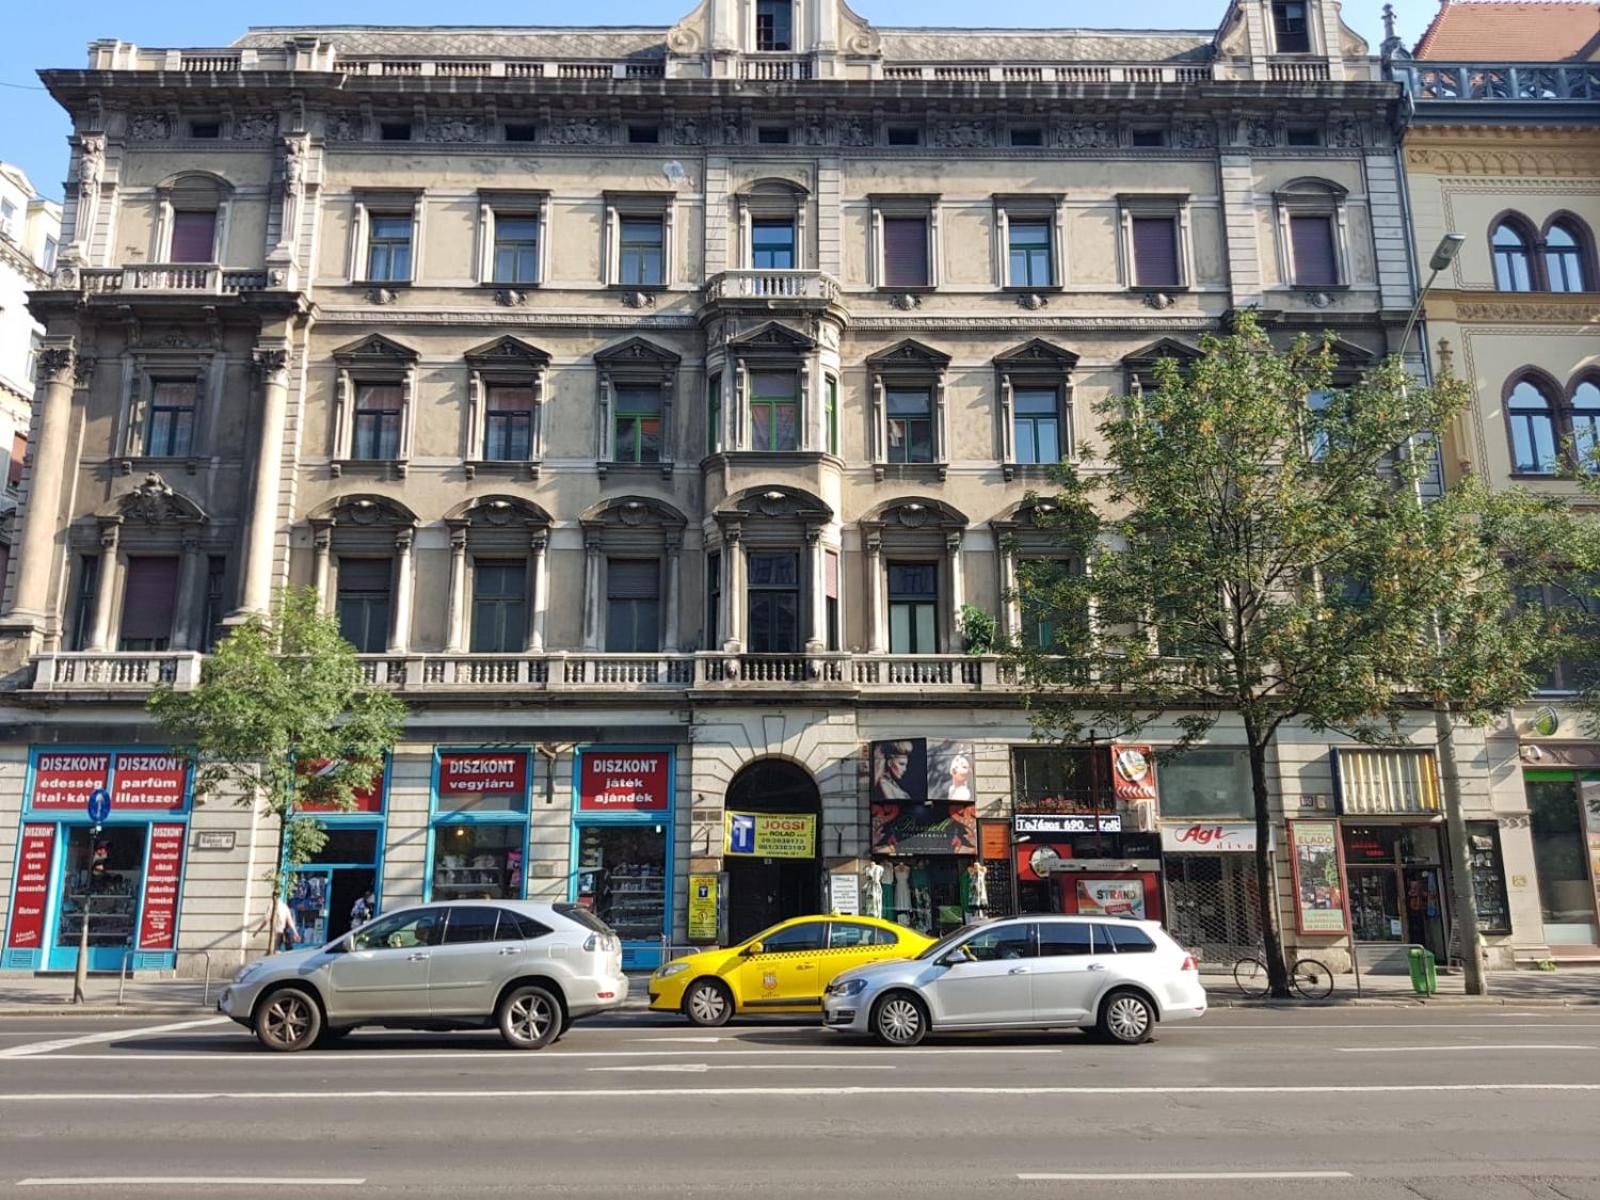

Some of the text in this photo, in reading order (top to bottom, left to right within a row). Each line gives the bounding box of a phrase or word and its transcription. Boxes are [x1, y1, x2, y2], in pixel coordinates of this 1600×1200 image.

[41, 757, 107, 771] DISZKONT
[449, 759, 515, 774] DISZKONT
[593, 759, 657, 773] DISZKONT
[40, 778, 103, 790] édesség
[121, 777, 177, 789] parfüm
[449, 779, 514, 790] vegyiáru
[605, 778, 643, 789] játék
[115, 791, 179, 803] illatszer
[594, 793, 653, 804] ajándék
[762, 820, 805, 831] JOGSI
